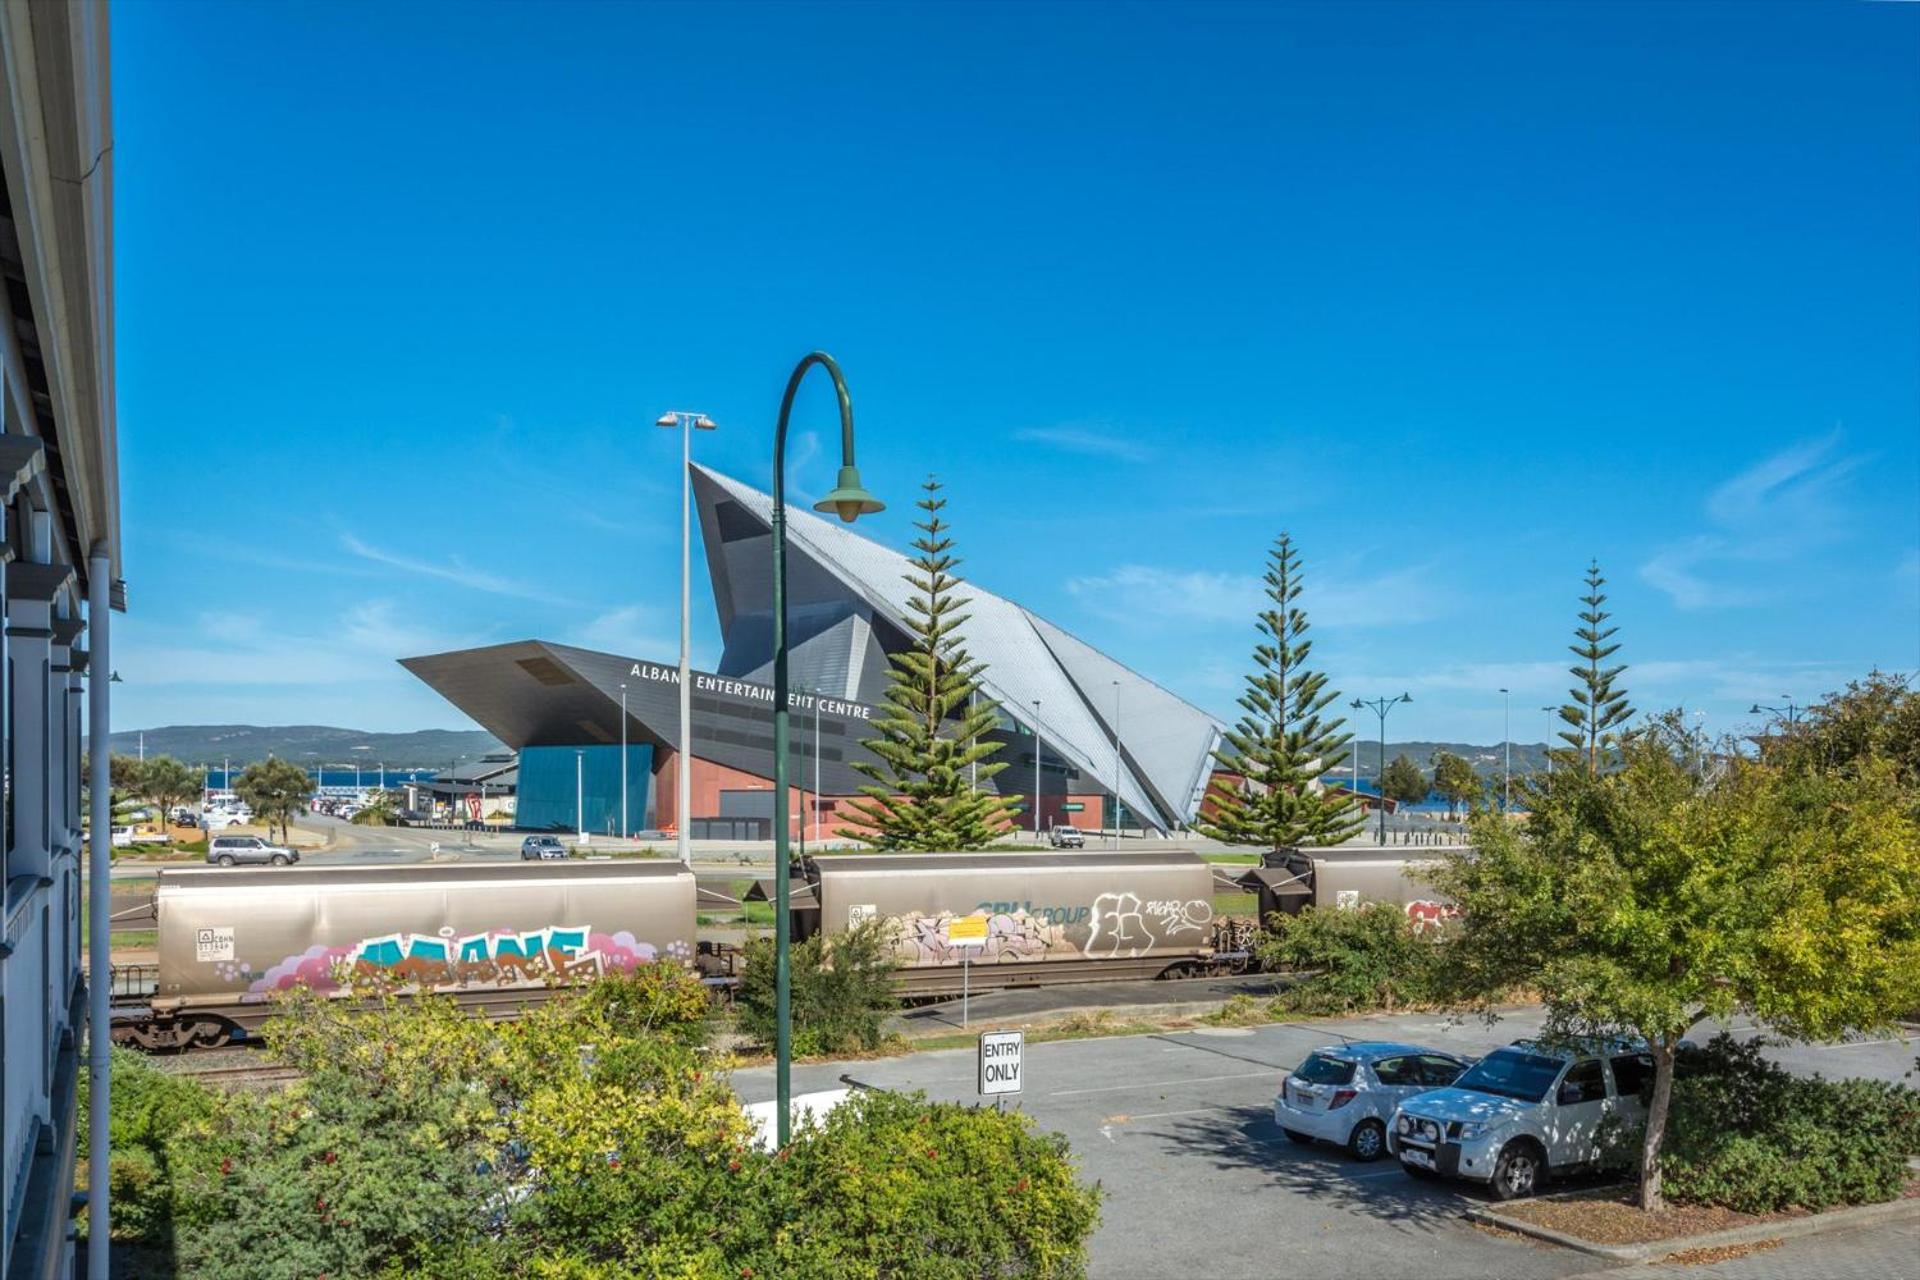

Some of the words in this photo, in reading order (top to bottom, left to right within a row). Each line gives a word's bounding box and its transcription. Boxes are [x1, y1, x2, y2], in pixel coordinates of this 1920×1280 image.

[630, 664, 691, 685] ALBAN
[696, 676, 814, 709] ENTERTAINENT
[818, 699, 870, 720] CENTRE
[985, 1042, 1020, 1058] ENTRY
[985, 1063, 1020, 1083] ONLY
